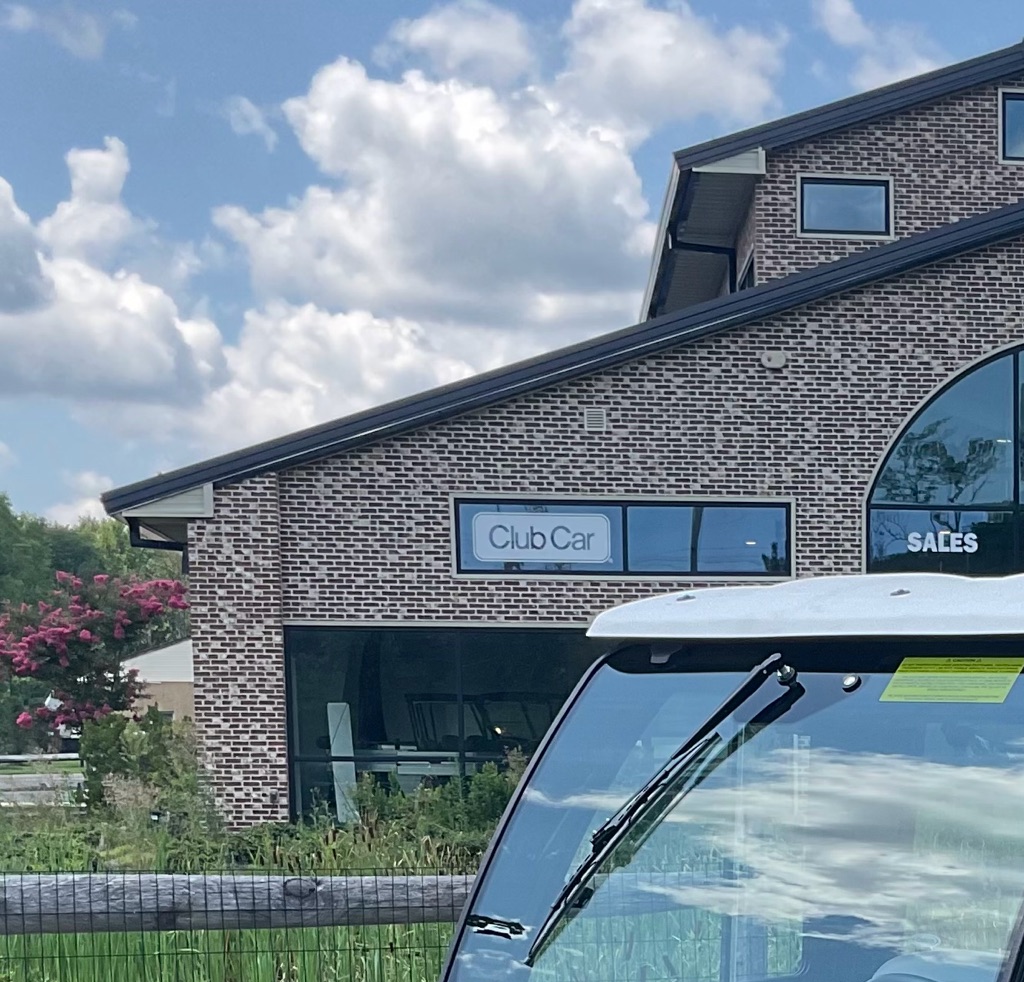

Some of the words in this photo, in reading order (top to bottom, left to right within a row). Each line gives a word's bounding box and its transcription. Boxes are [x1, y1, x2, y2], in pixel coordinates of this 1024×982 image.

[488, 524, 546, 551] Club
[550, 525, 596, 551] Car
[907, 532, 979, 554] SALES
